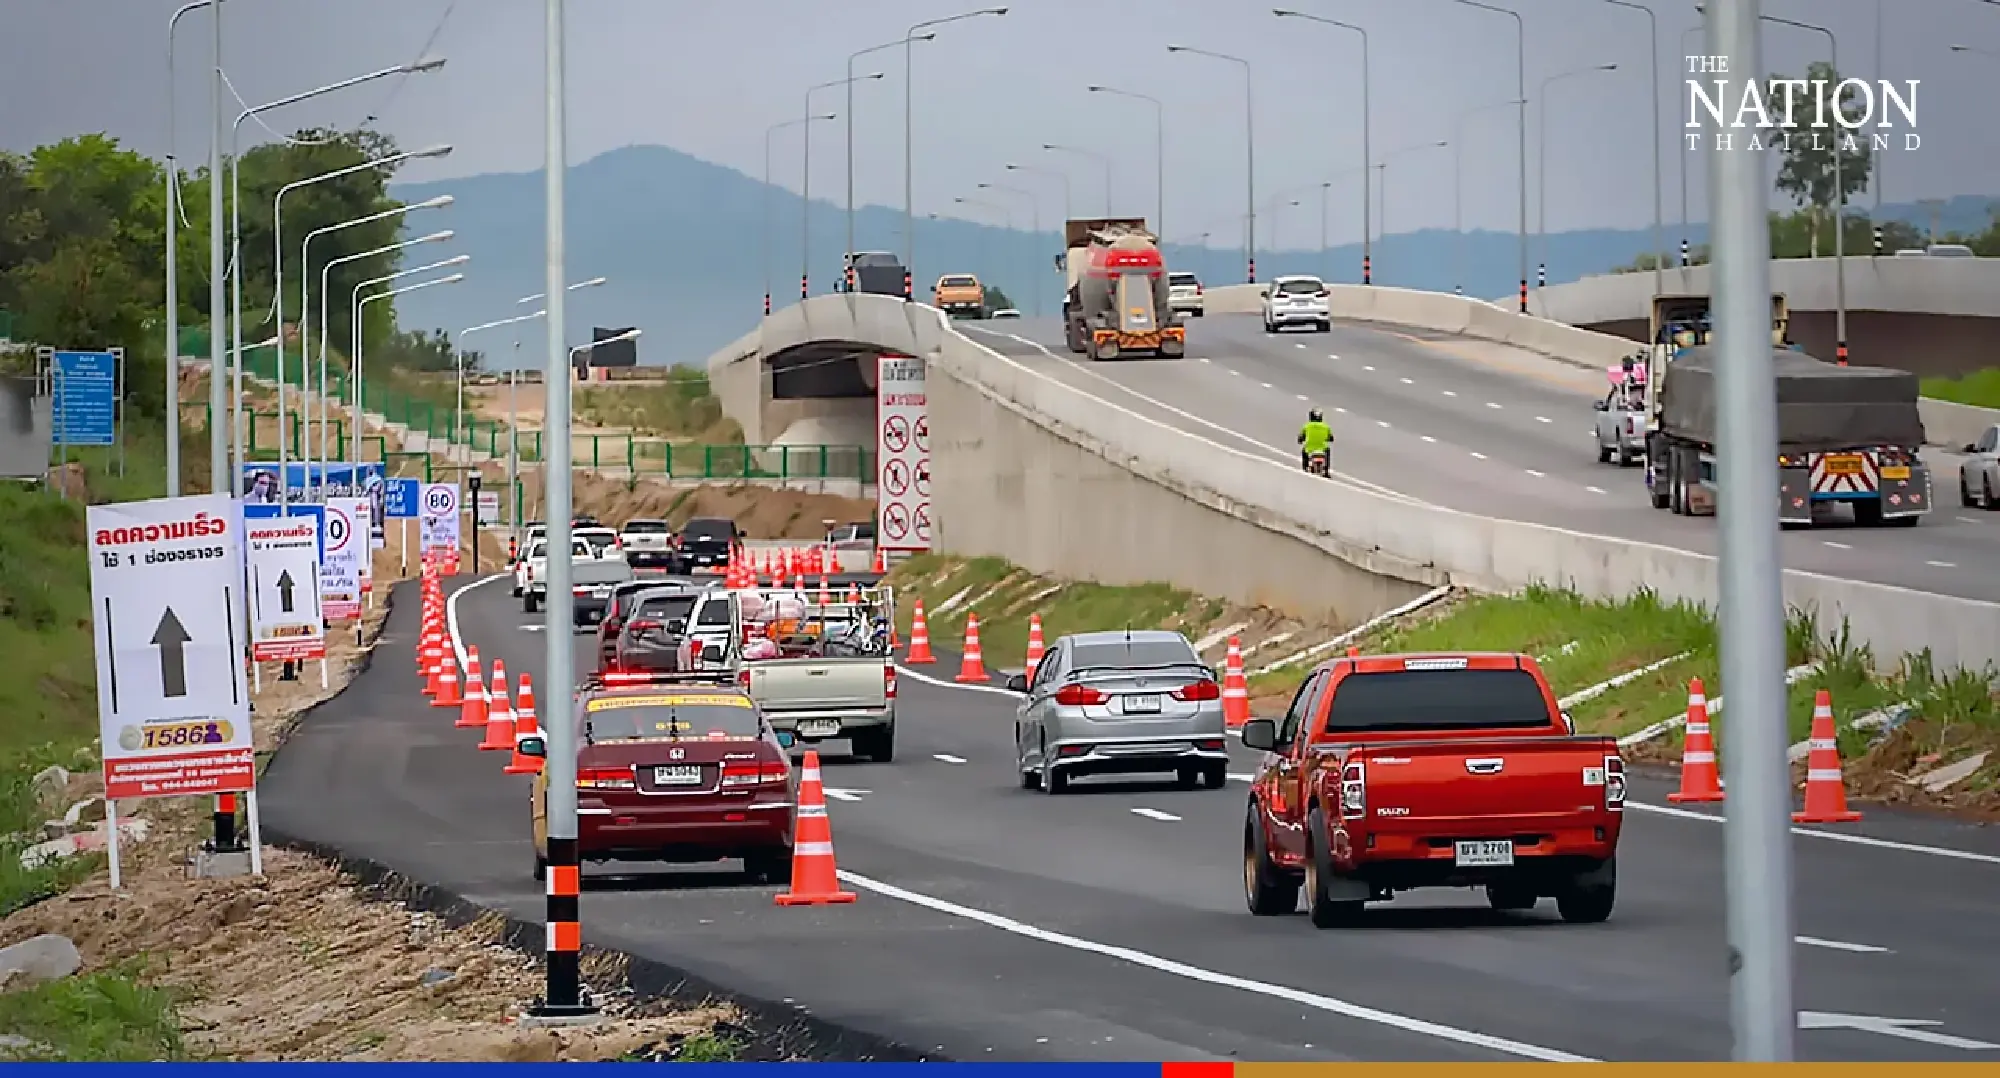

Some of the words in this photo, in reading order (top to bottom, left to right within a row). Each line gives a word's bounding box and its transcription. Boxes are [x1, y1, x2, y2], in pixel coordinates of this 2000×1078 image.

[430, 494, 449, 508] 80
[95, 512, 226, 545] ลดความเร็ว
[128, 554, 136, 567] 1
[145, 547, 224, 564] ช่องจราจร
[144, 726, 203, 748] 1586
[1377, 807, 1409, 816] ISUZU
